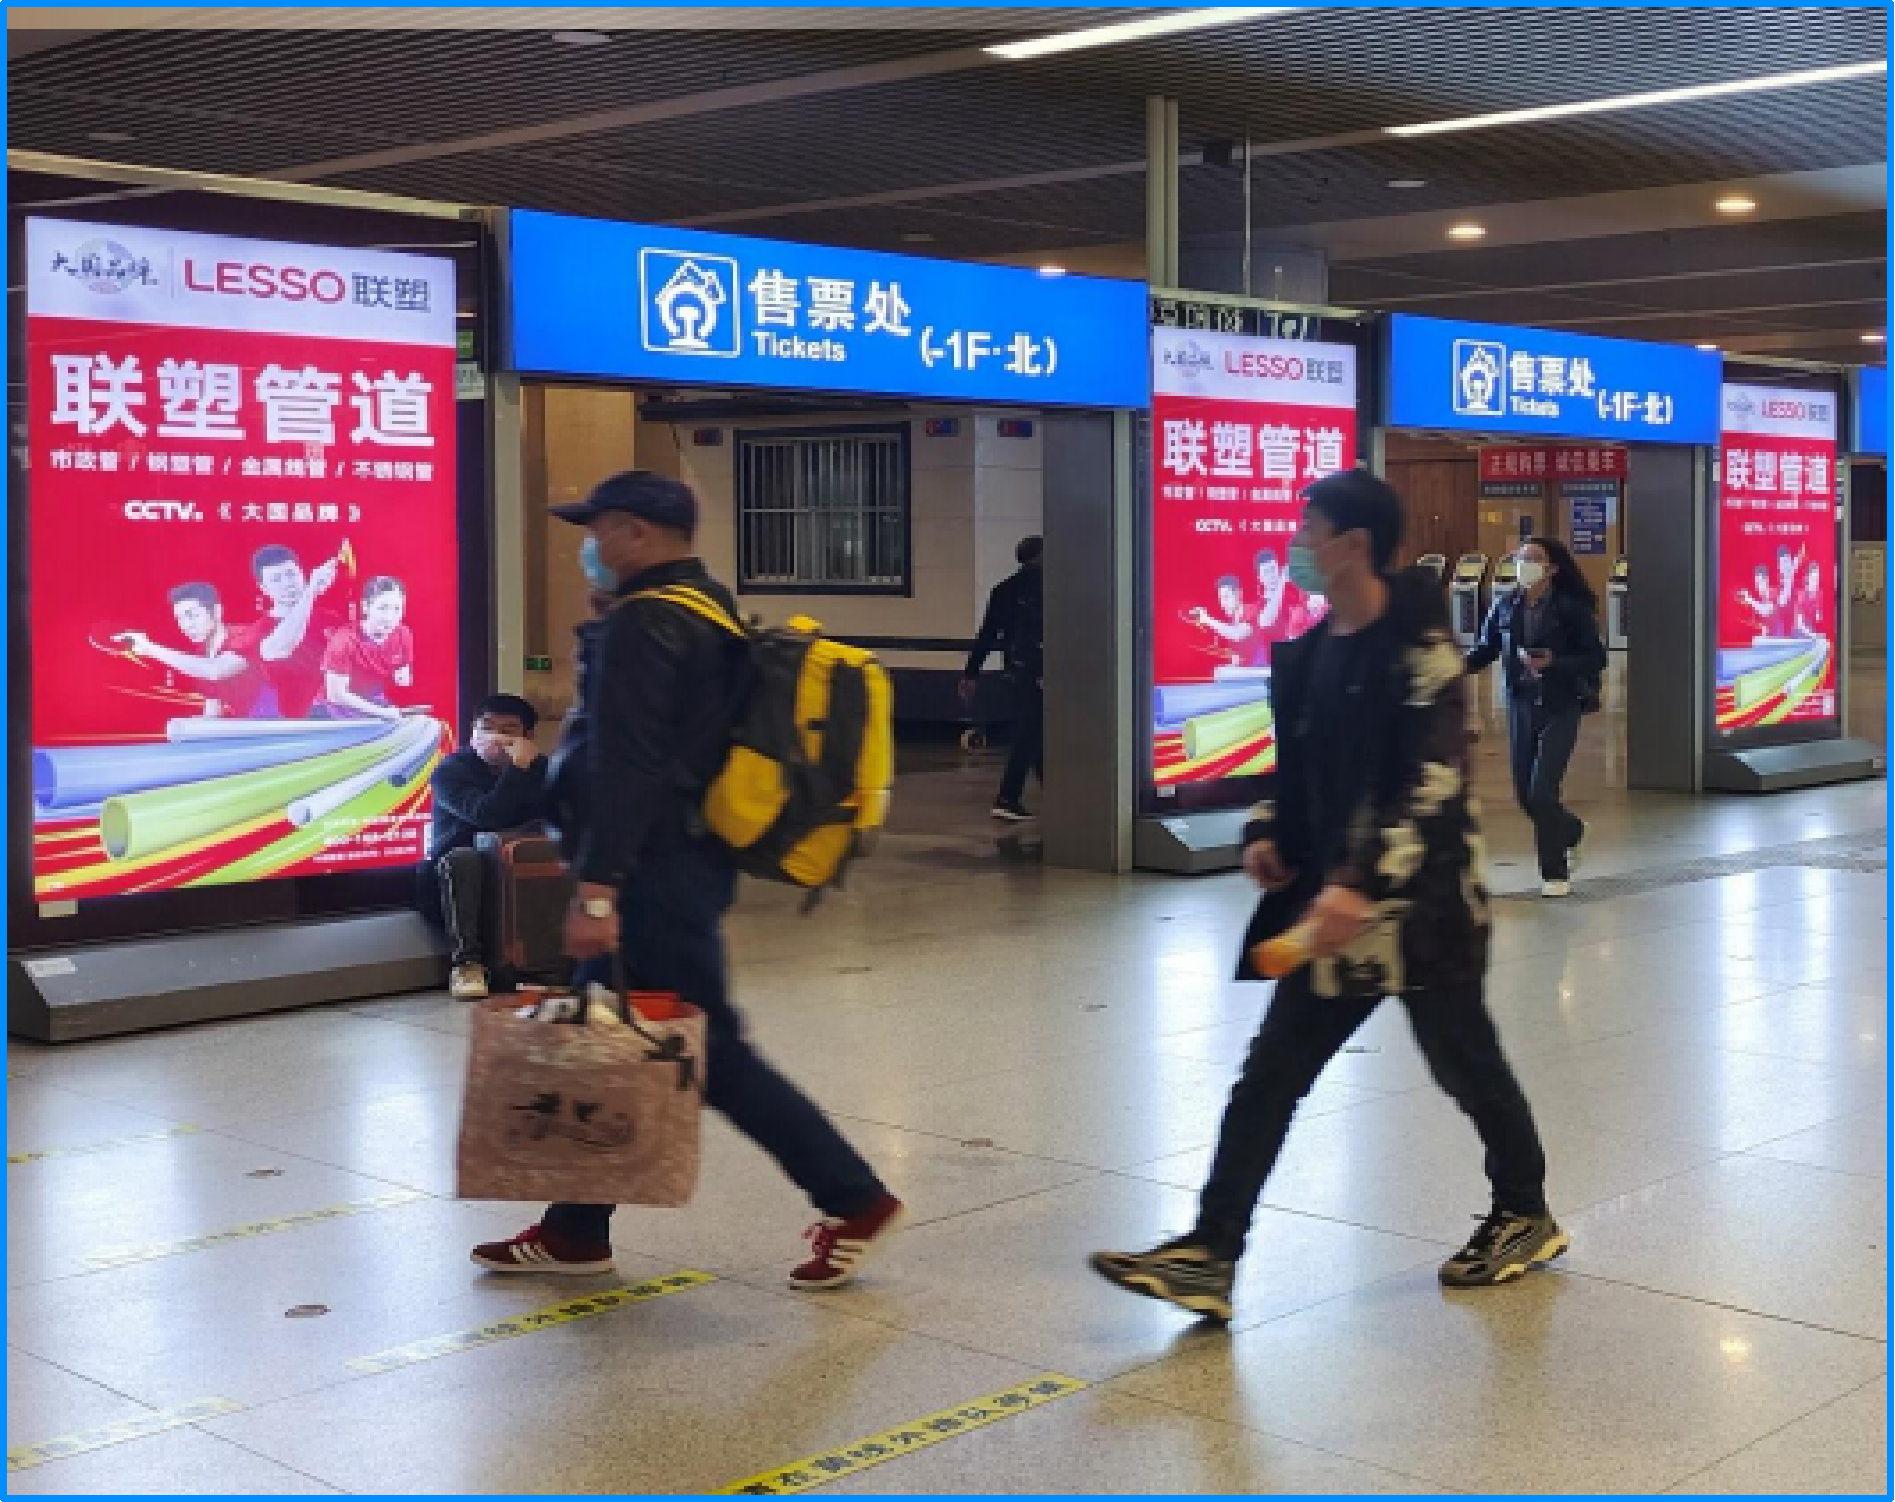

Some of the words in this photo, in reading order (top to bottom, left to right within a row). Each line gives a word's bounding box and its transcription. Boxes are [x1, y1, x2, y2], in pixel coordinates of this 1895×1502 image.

[184, 258, 346, 304] LESSO
[352, 272, 432, 312] 联塑
[747, 269, 912, 338] 售票处
[751, 331, 846, 362] Tickets
[1224, 350, 1303, 381] LESSO
[1509, 350, 1596, 397] 售票处
[50, 352, 434, 446] 联塑管道
